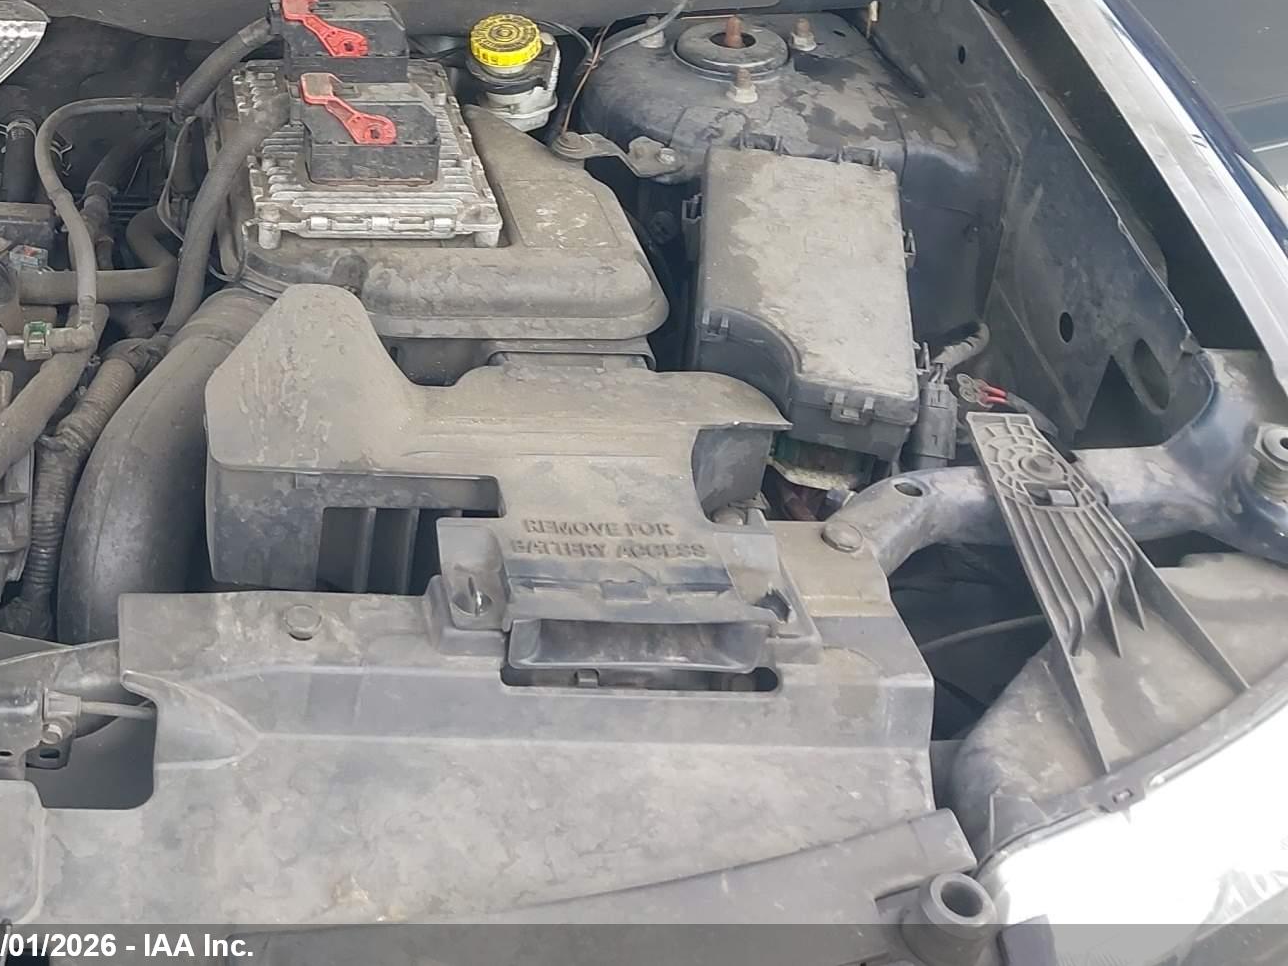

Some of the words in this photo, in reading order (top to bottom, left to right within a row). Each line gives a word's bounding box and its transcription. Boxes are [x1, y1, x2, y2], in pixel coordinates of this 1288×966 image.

[522, 519, 620, 537] REMOVE
[624, 521, 675, 537] FOR
[510, 539, 607, 559] BATTERY
[615, 542, 708, 559] ACCESS
